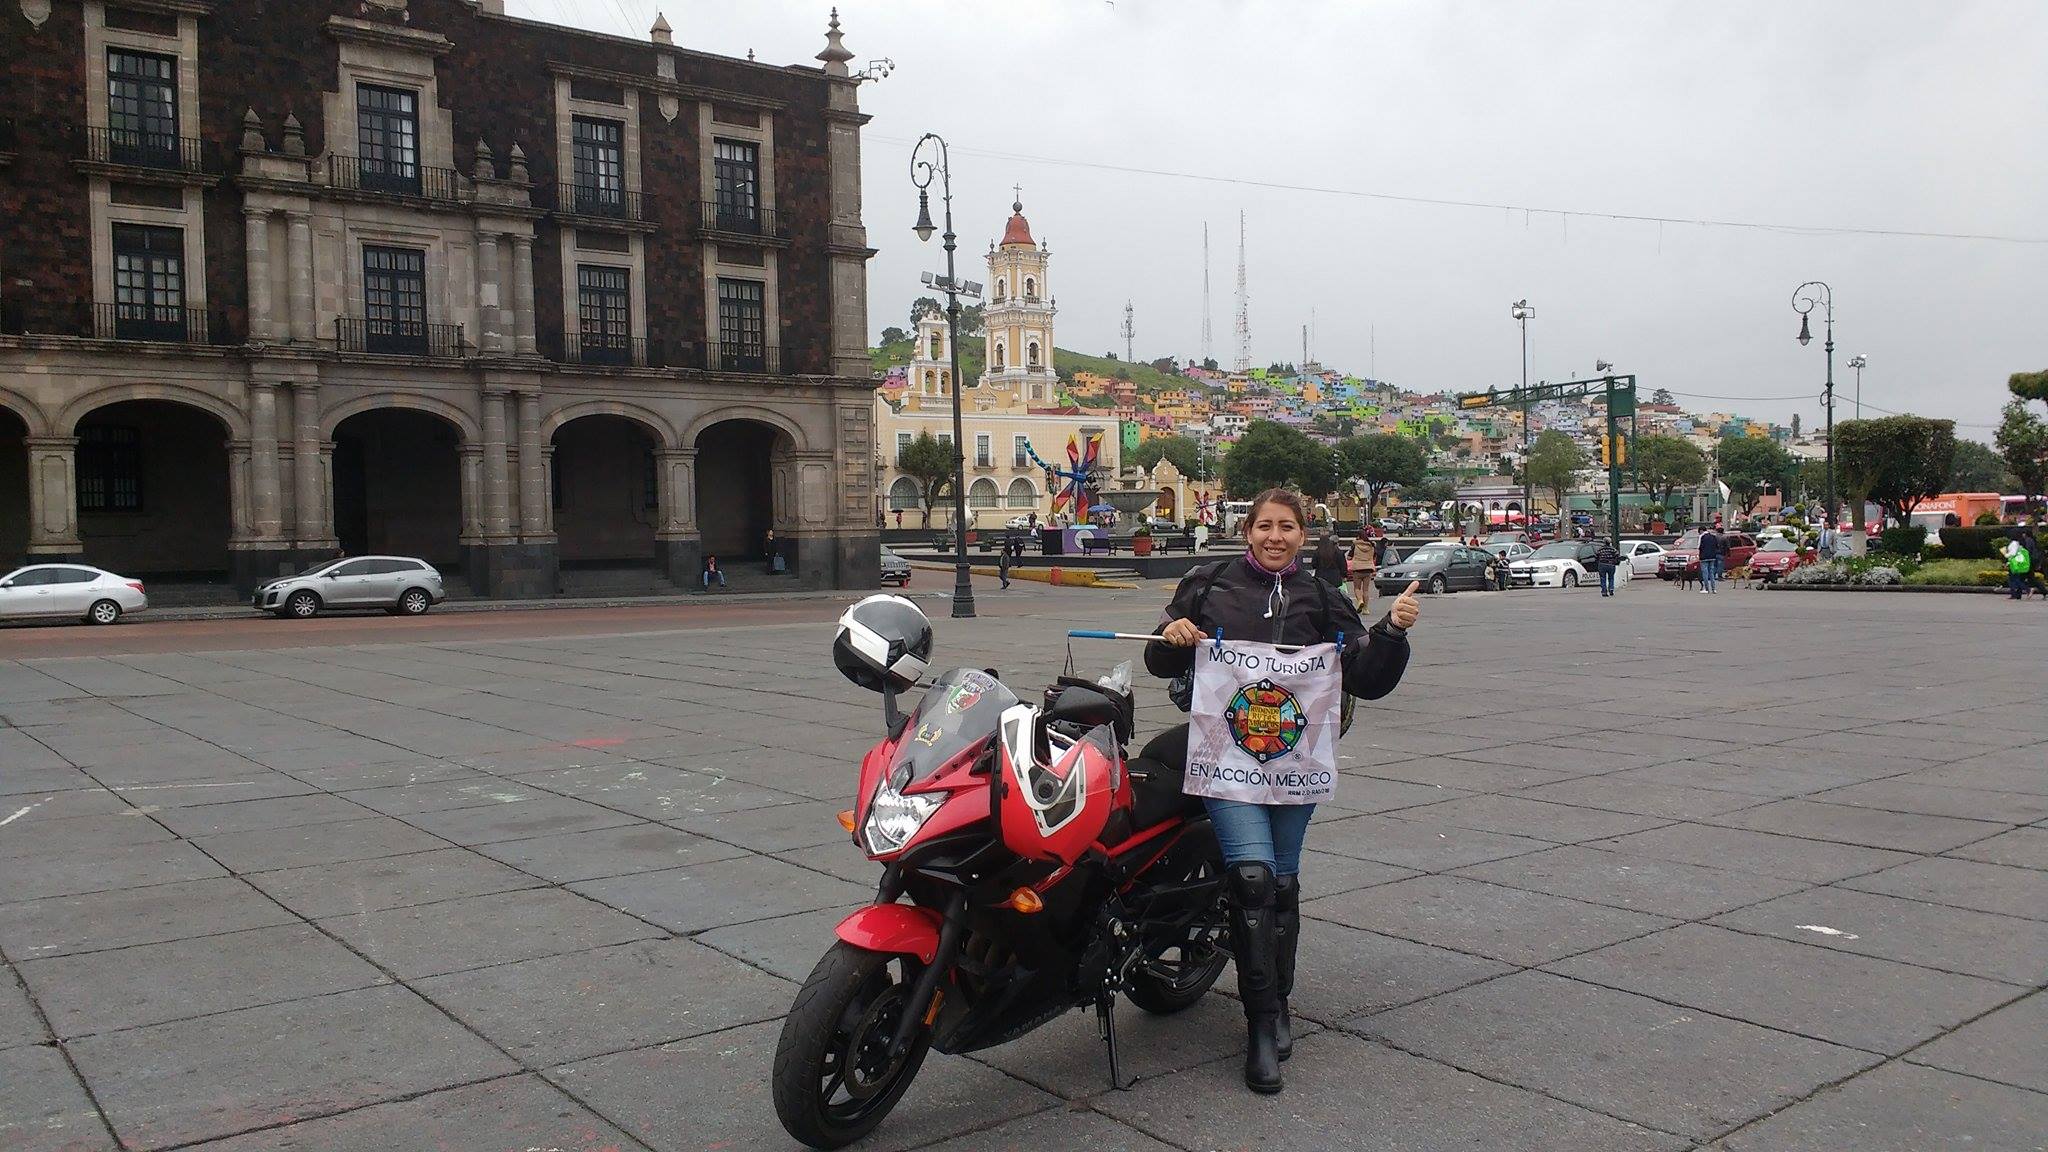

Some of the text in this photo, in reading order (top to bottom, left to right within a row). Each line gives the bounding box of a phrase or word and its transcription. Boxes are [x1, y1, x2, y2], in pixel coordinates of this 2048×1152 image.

[1209, 647, 1326, 674] MOTO TURISTA
[1226, 711, 1234, 719] O
[1252, 713, 1277, 721] RUTAS
[1297, 718, 1305, 726] E
[1190, 762, 1331, 787] EN ACCIÓN MÉXICO
